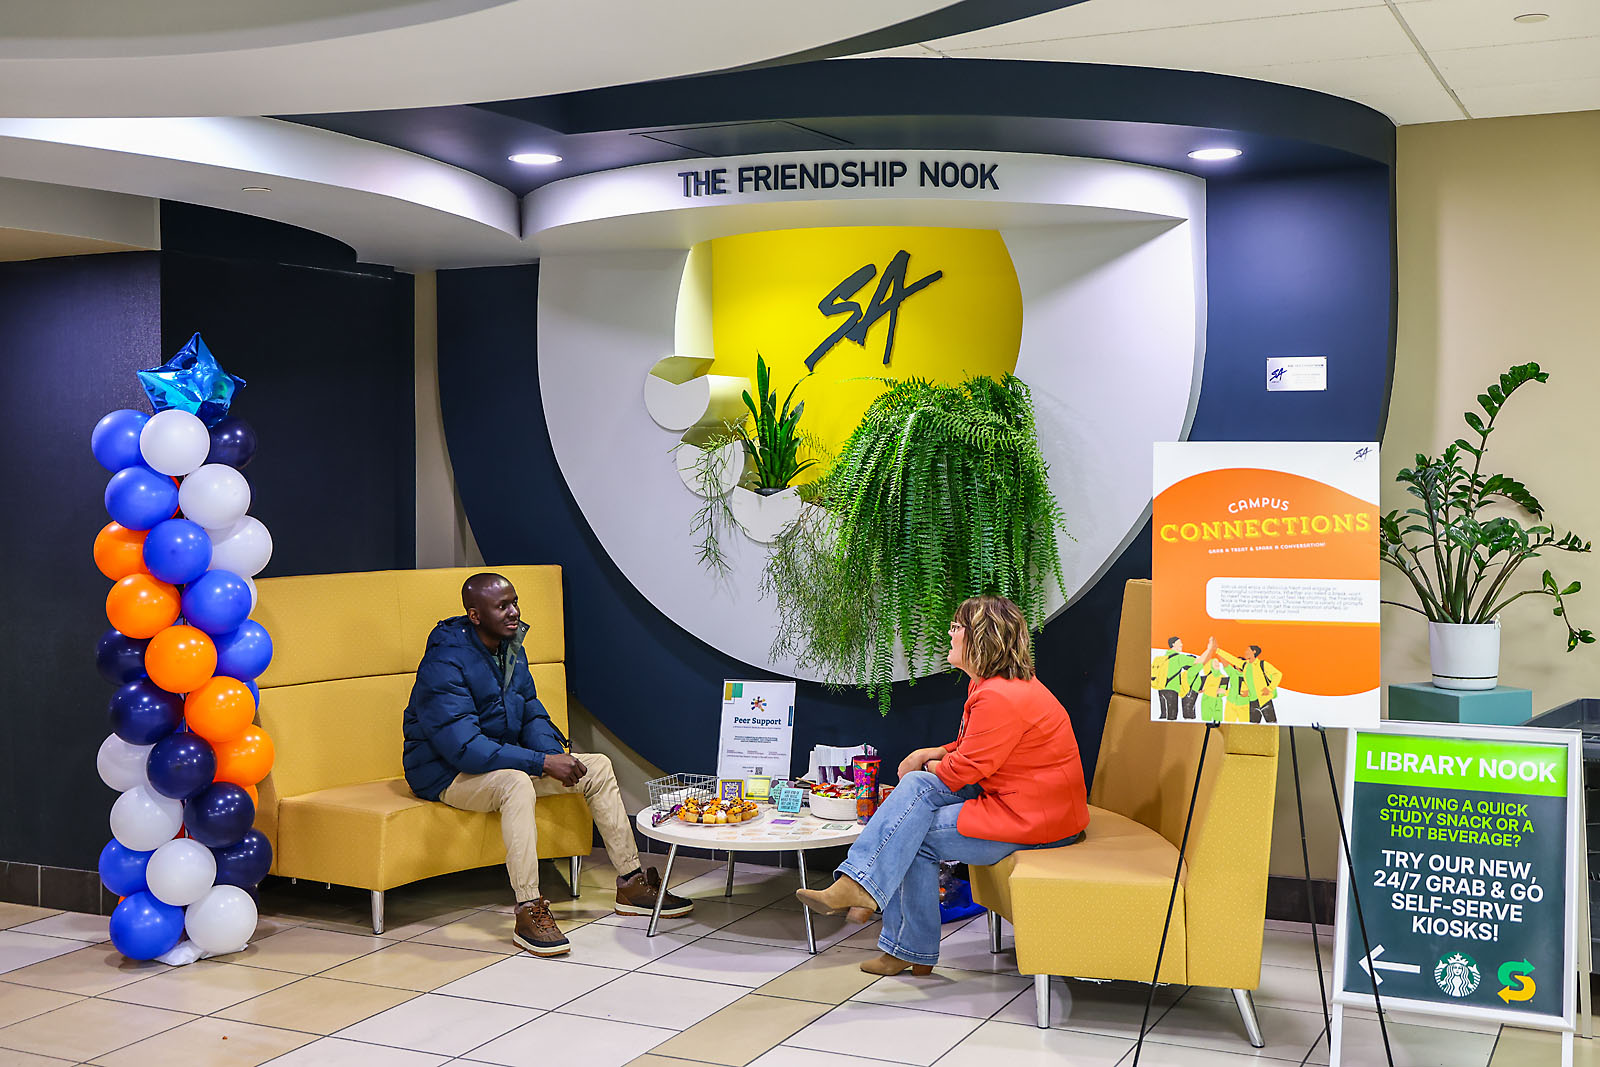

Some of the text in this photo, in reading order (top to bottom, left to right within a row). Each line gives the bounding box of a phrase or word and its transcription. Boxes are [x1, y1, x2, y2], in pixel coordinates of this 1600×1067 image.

[678, 161, 1000, 197] THE FRIENDSHIP NOOK
[804, 250, 943, 372] SA
[1228, 497, 1290, 514] CAMPUS
[1160, 513, 1370, 542] CONNECTIONS
[734, 716, 782, 726] Peer Support
[1366, 750, 1557, 784] LIBRARY NOOK
[1387, 793, 1529, 818] CRAVING A QUICK
[1379, 808, 1535, 833] STUDY SNACK OR A
[1390, 824, 1522, 848] HOT BEVERAGE?
[1381, 850, 1537, 884] TRY OUR NEW,
[1373, 870, 1544, 903] 24/7 GRAB & GO
[1391, 892, 1523, 923] SELF-SERVE
[1412, 916, 1499, 942] KIOSKS!
